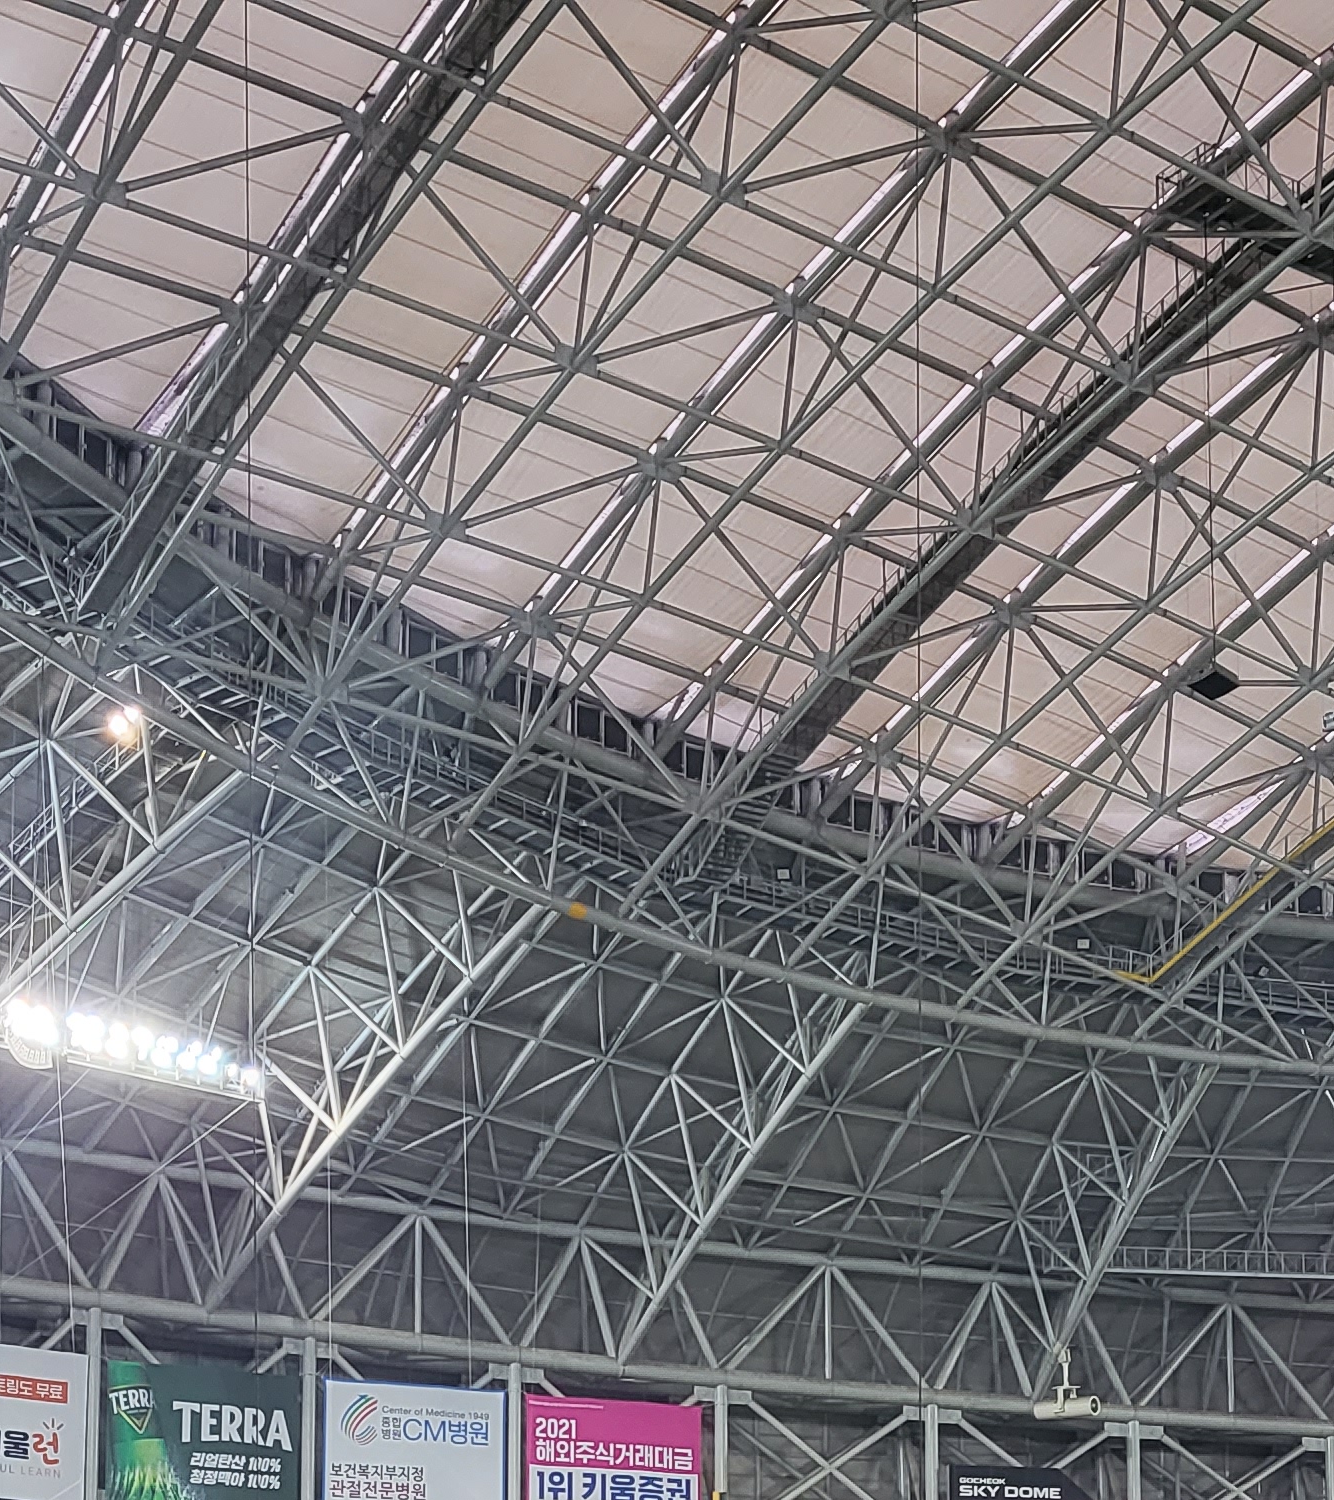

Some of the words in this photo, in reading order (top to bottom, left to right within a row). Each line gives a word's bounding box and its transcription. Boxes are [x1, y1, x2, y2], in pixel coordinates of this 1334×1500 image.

[36, 1382, 63, 1399] 무료
[108, 1387, 156, 1414] TERRA
[381, 1416, 402, 1428] 종합
[382, 1405, 411, 1415] Center
[414, 1407, 424, 1416] of
[426, 1408, 465, 1419] Medicine
[468, 1411, 490, 1421] 1949
[172, 1400, 293, 1452] TERRA
[381, 1428, 402, 1440] 병원
[402, 1418, 489, 1446] CM병원
[535, 1417, 577, 1439] 2021
[189, 1452, 246, 1470] 리얼탄산
[535, 1438, 694, 1471] 해외주식거래대금
[20, 1465, 61, 1479] LEARN
[330, 1463, 424, 1482] 보건복지부지정
[329, 1479, 427, 1500] 관절전문병원
[537, 1471, 573, 1500] 1위
[959, 1485, 1000, 1497] SKY
[1004, 1486, 1062, 1499] DOME
